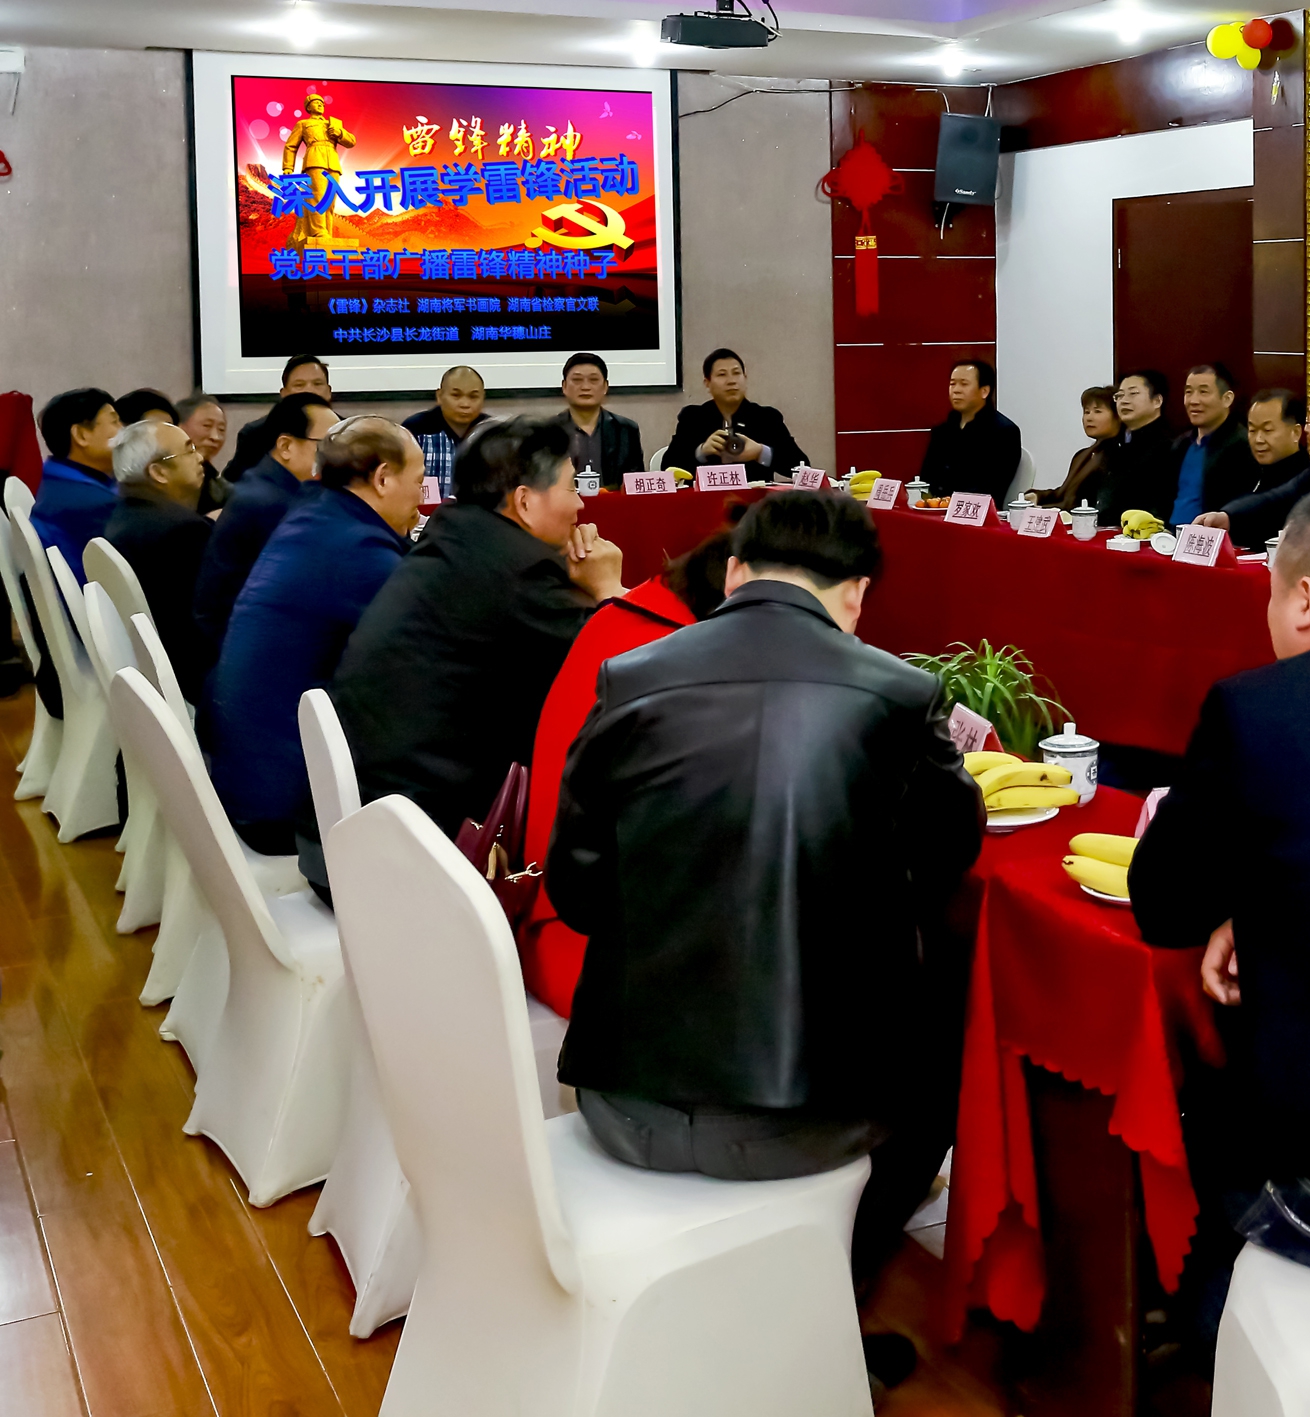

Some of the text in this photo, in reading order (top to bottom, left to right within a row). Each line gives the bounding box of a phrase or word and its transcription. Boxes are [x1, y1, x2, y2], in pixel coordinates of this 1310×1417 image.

[267, 153, 640, 217] 深入开展学雷锋活动
[268, 247, 618, 280] 党员干部广播雷锋精神种子
[417, 297, 501, 313] 湖南将军书画院
[333, 327, 459, 342] 中共长沙县长龙街道
[707, 471, 742, 486] 许正林
